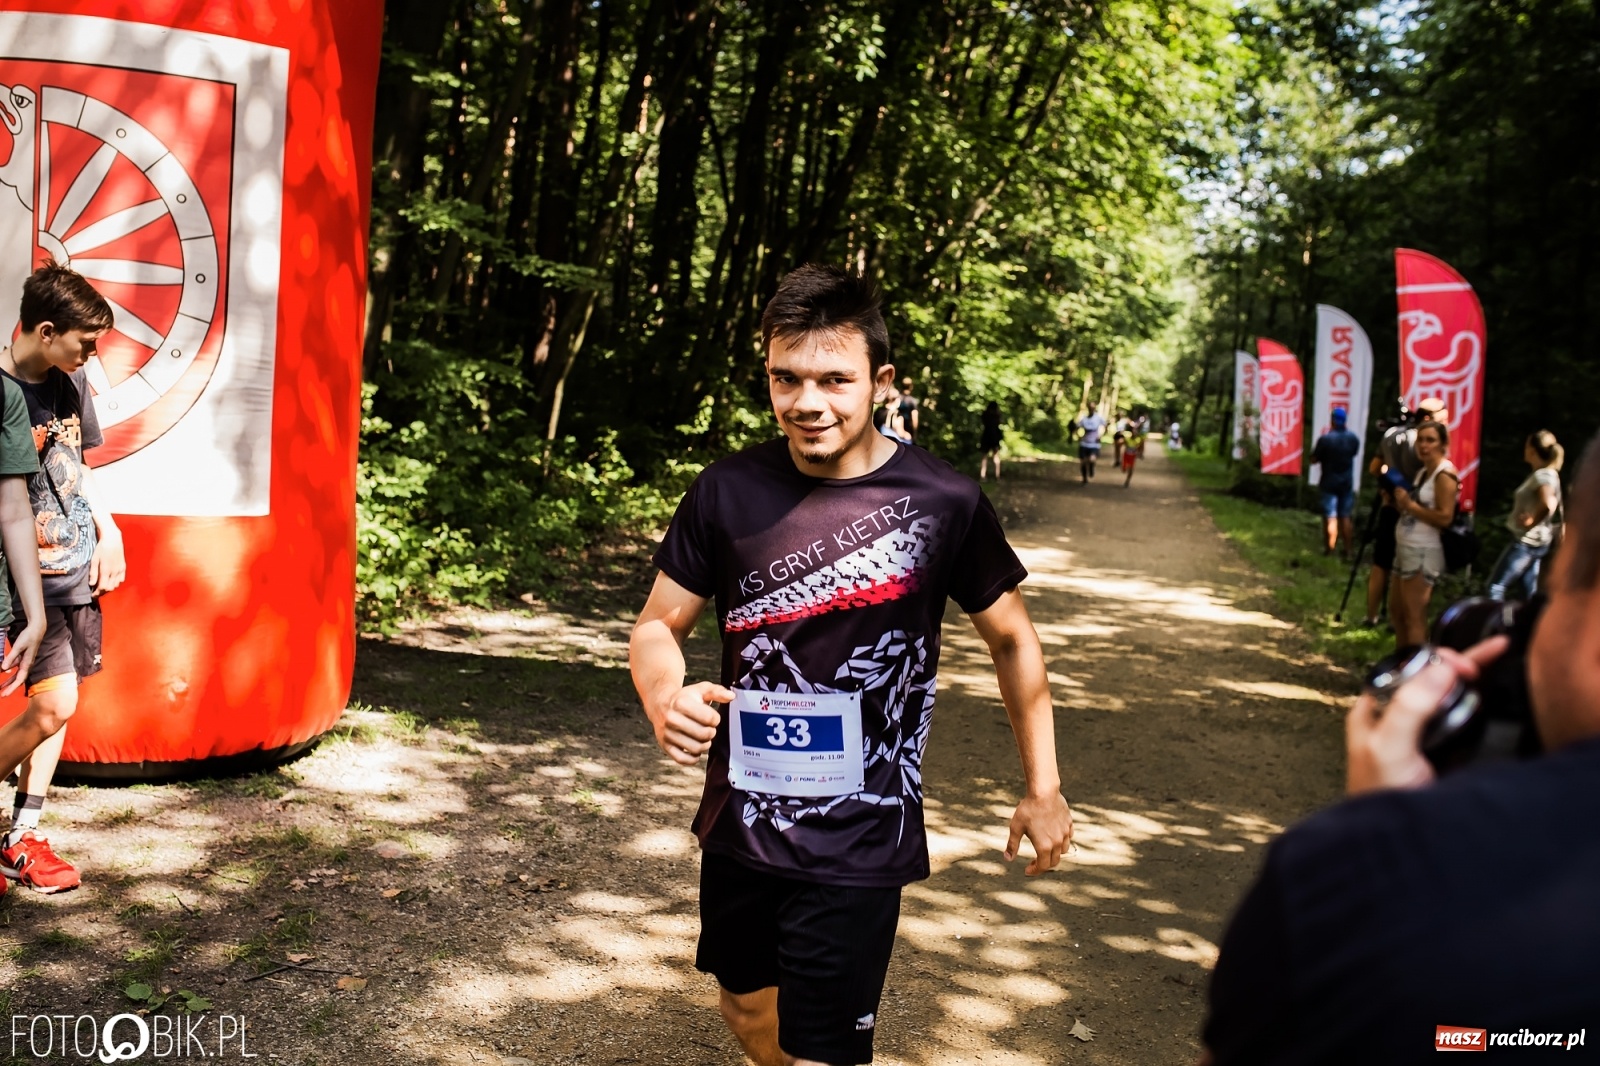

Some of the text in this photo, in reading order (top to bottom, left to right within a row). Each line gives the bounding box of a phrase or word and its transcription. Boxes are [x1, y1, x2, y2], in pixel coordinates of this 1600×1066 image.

[738, 495, 919, 597] KS GRYF KIETRZ
[771, 699, 816, 708] TROPEMWILCZYM
[765, 716, 812, 748] 33
